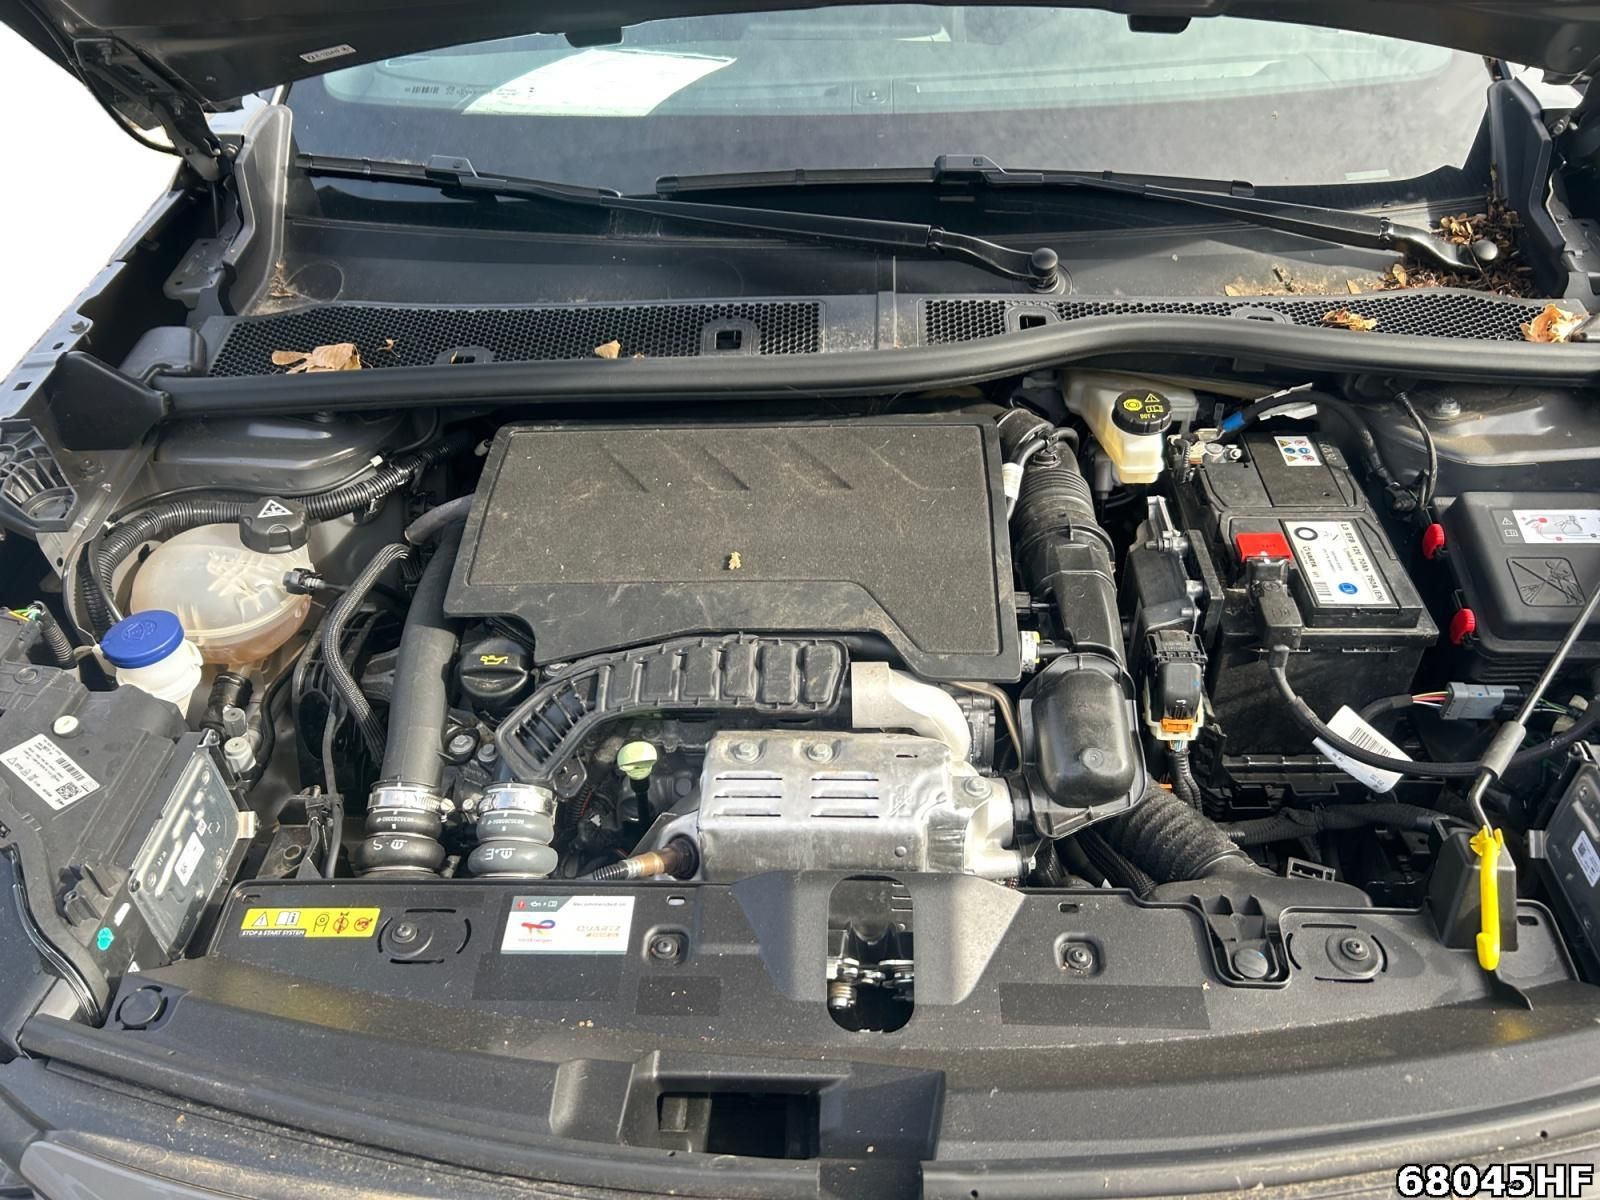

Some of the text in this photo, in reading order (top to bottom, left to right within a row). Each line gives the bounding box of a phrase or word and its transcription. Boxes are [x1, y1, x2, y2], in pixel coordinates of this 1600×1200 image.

[1345, 532, 1356, 543] EFB
[1352, 545, 1361, 555] 12V
[1359, 558, 1369, 572] 70Ah
